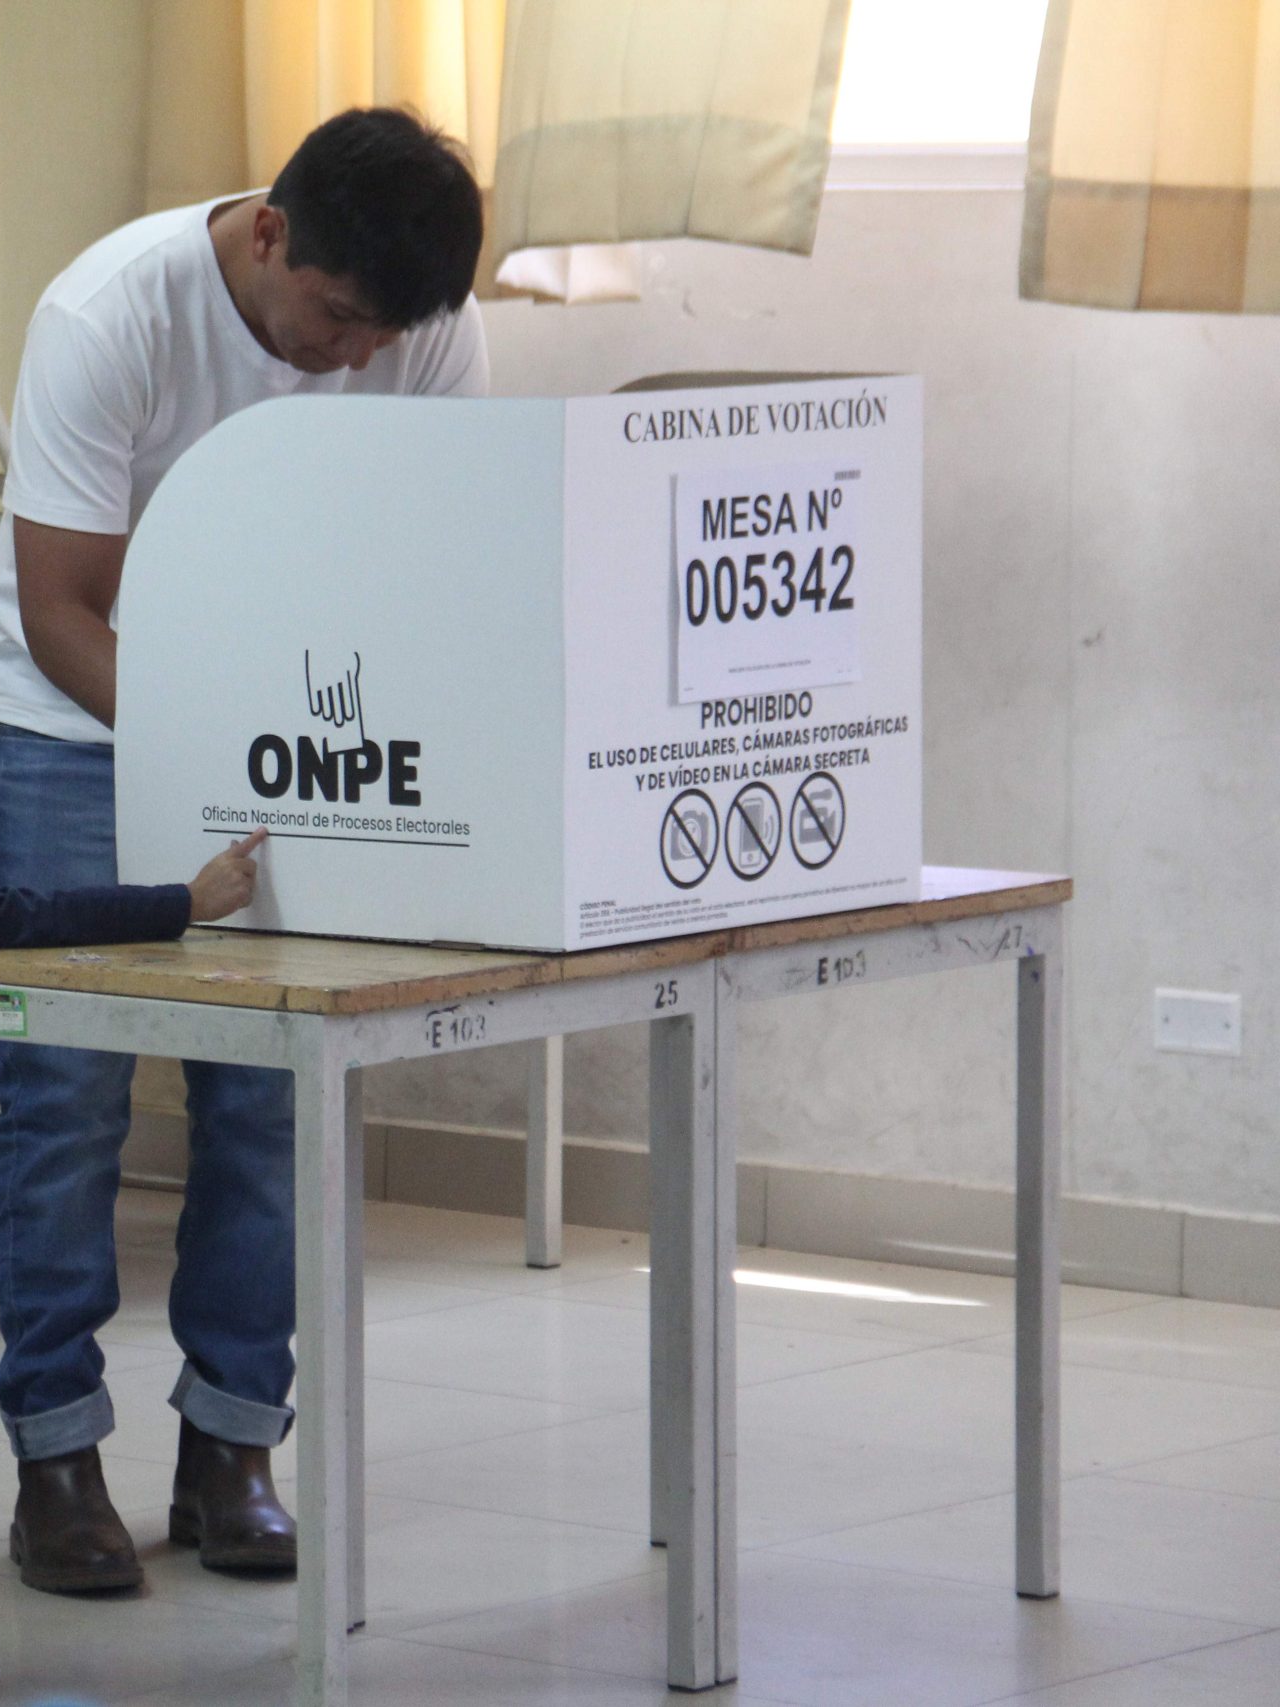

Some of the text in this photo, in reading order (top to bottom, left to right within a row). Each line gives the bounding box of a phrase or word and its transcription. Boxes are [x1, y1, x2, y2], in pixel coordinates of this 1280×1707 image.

[623, 389, 888, 443] CABINA DE VOTACIÓN
[702, 493, 797, 541] MESA
[686, 545, 855, 627] 005342
[701, 691, 813, 729] PROHIBIDO
[588, 715, 909, 769] EL USO DE CELULARES, CÁMARAS FOTOGRÁFICAS
[248, 734, 421, 807] ONPE
[636, 748, 870, 792] Y DE VÍDEO EN LA CÁMARA SECRETA
[202, 806, 470, 836] Oficina Nacional de Procesos Electorales
[817, 957, 828, 985] E
[654, 980, 678, 1009] 25
[432, 1020, 442, 1048] E
